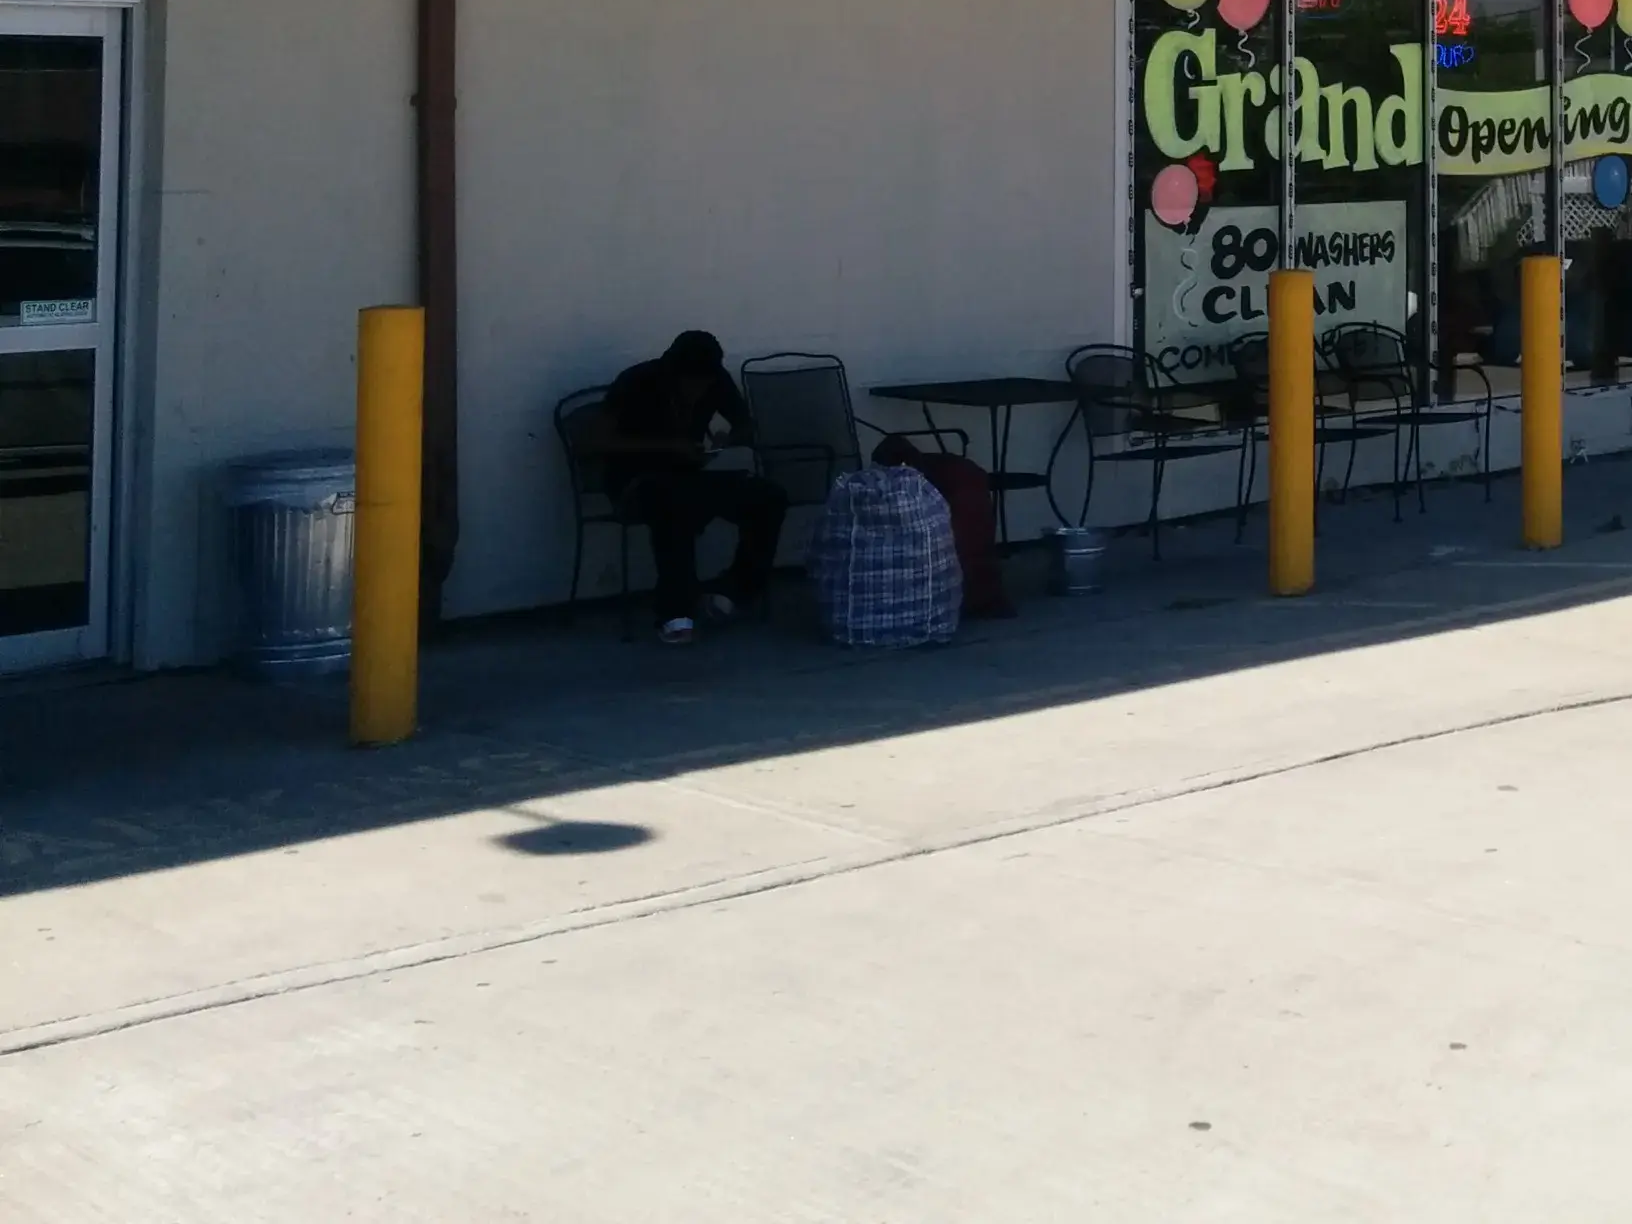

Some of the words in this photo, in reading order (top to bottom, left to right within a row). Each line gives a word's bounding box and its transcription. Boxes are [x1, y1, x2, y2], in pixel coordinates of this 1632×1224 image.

[1144, 28, 1423, 172] Grand
[1211, 225, 1278, 279] 80
[25, 303, 56, 313] STAND
[59, 301, 89, 311] CLEAR
[1202, 281, 1356, 324] CLN
